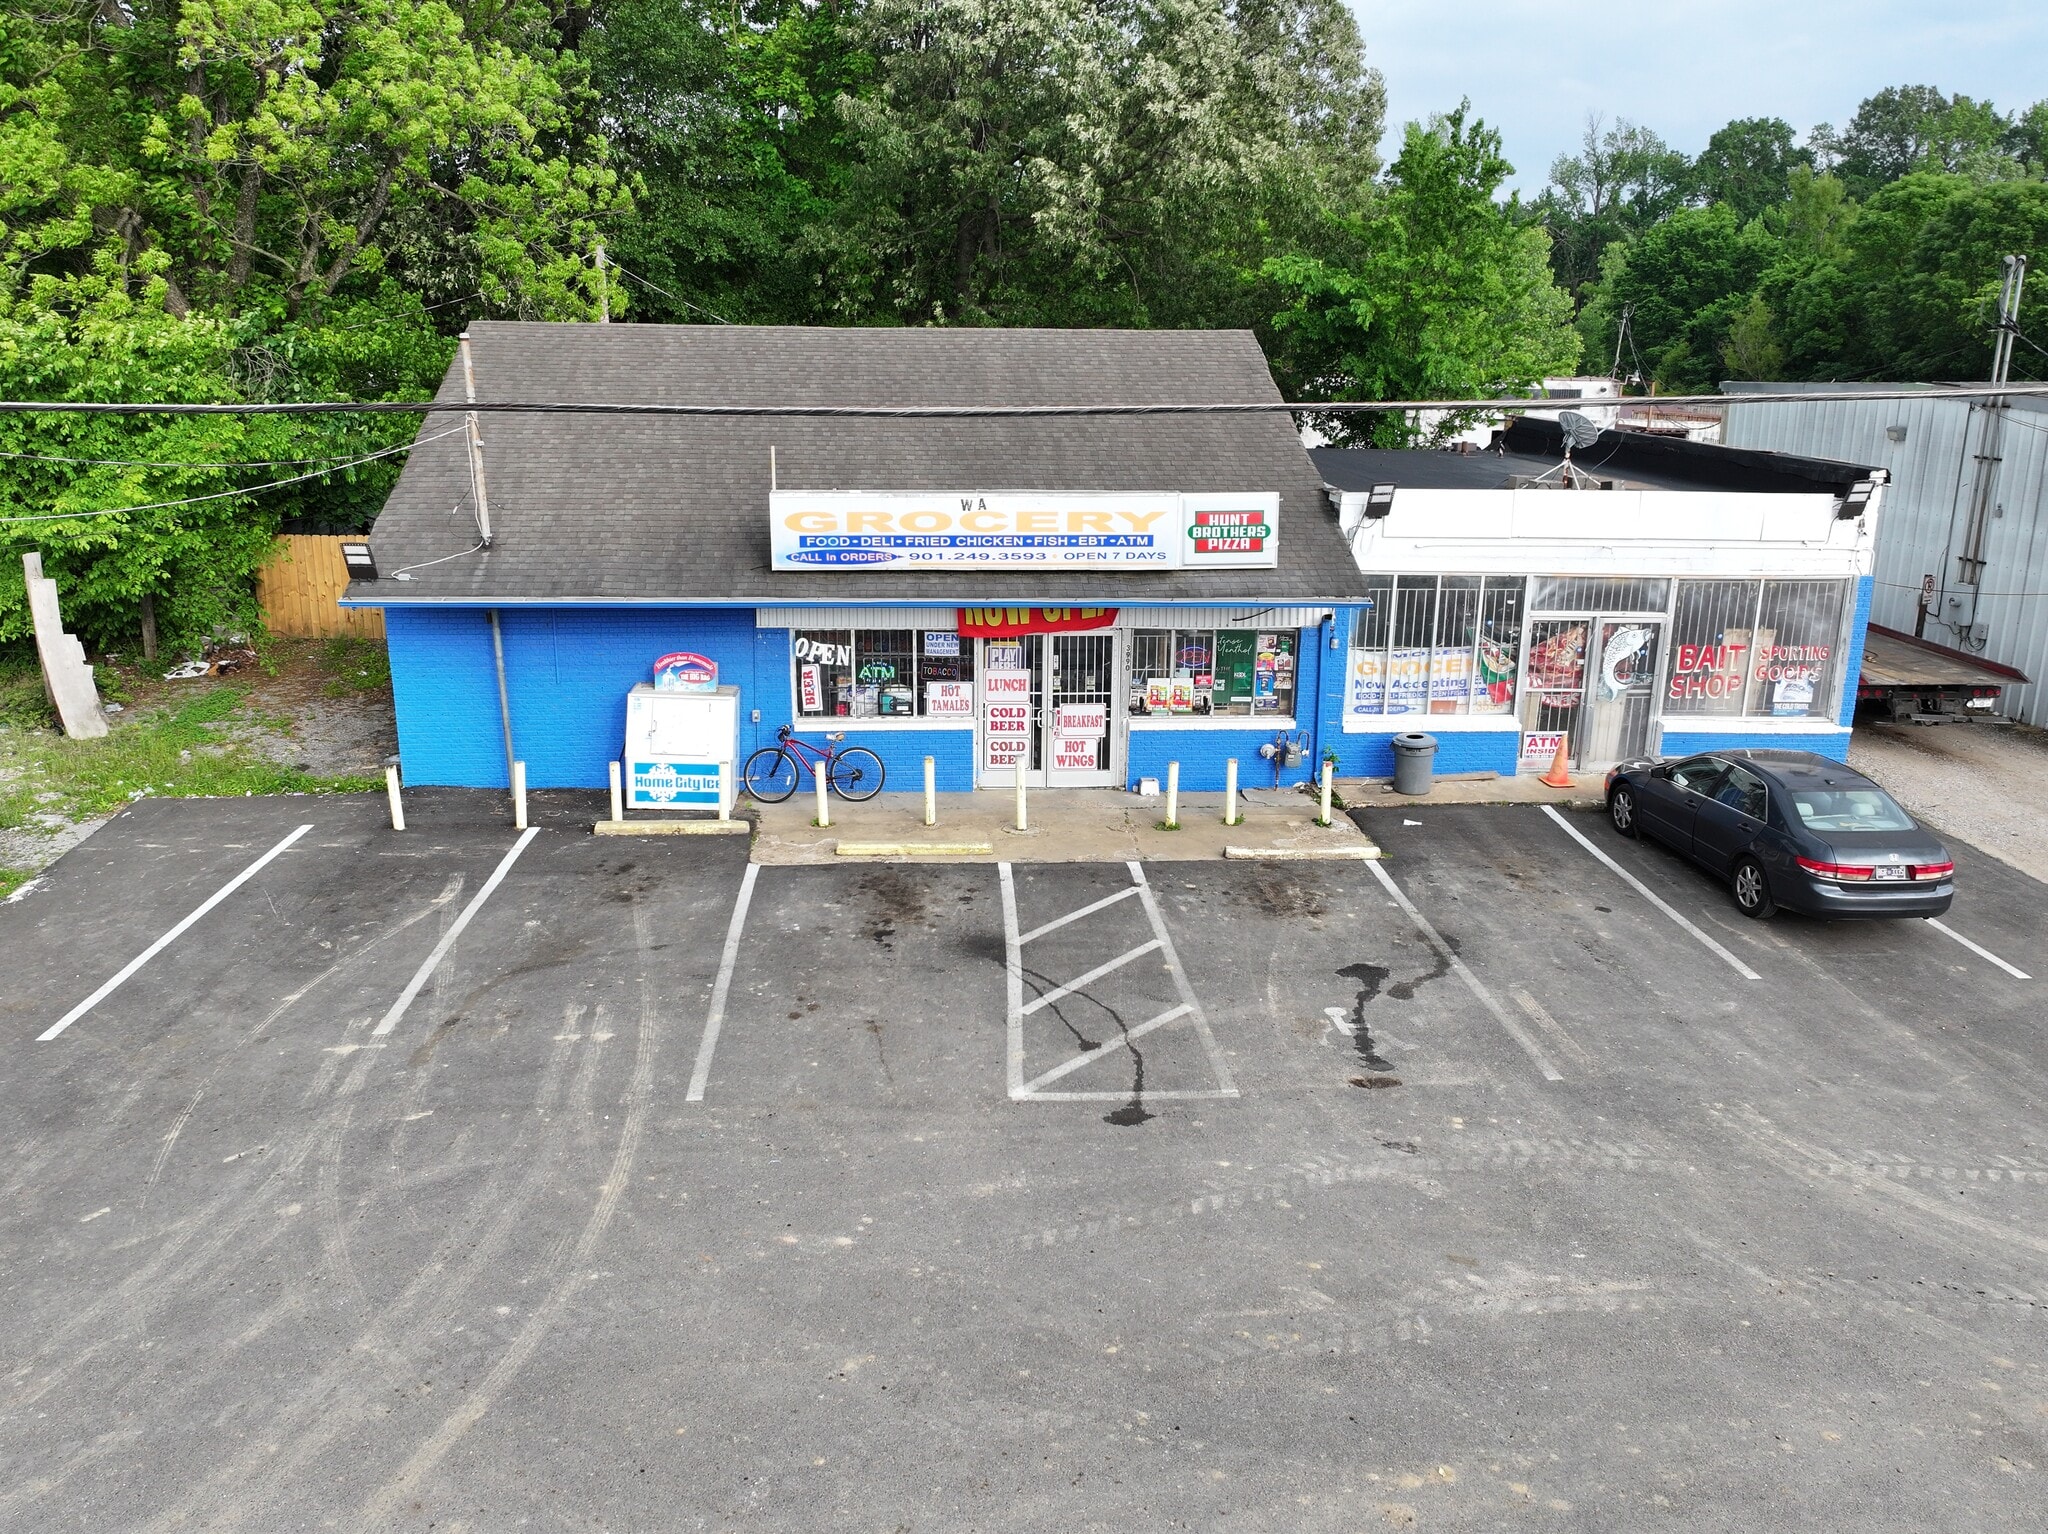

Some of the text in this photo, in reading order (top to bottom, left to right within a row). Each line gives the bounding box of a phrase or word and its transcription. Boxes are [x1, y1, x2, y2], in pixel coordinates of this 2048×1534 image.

[784, 511, 1168, 533] GROCERY
[1208, 513, 1250, 526] HUNT
[1192, 525, 1267, 538] BROTHERS
[806, 536, 1149, 547] FOOD DELI FRIED CHICKEN FISH EBT ATM
[1207, 538, 1250, 550] PIZZA
[790, 552, 823, 562] CALL
[840, 552, 893, 562] ORDERS
[909, 552, 1047, 561] 901.249.3593
[1063, 552, 1108, 560] OPEN
[1113, 552, 1120, 560] 7
[1125, 552, 1167, 560] DAYS
[926, 633, 958, 642] OPEN
[796, 638, 851, 666] OPEN
[991, 649, 1017, 661] PLAY
[1176, 651, 1211, 663] OPEN
[1759, 645, 1830, 662] SPORTING
[1676, 644, 1746, 673] BAIT
[859, 667, 894, 678] ATM
[923, 667, 957, 676] TOBACCO
[1754, 664, 1822, 683] GOODS
[803, 670, 816, 706] BEER
[988, 679, 1027, 691] LUNCH
[1392, 676, 1467, 689] Accepting
[1669, 674, 1742, 699] SHOP
[941, 685, 960, 697] HOT
[932, 700, 969, 711] TAMALES
[990, 708, 1026, 718] COLD
[990, 721, 1025, 731] BEER
[1063, 715, 1103, 728] BREAKFAST
[990, 742, 1026, 751] COLD
[1064, 741, 1086, 753] HOT
[1527, 737, 1562, 748] ATM
[990, 755, 1016, 764] BEE
[1056, 755, 1094, 767] WINGS
[635, 776, 673, 788] Home
[675, 777, 701, 791] City
